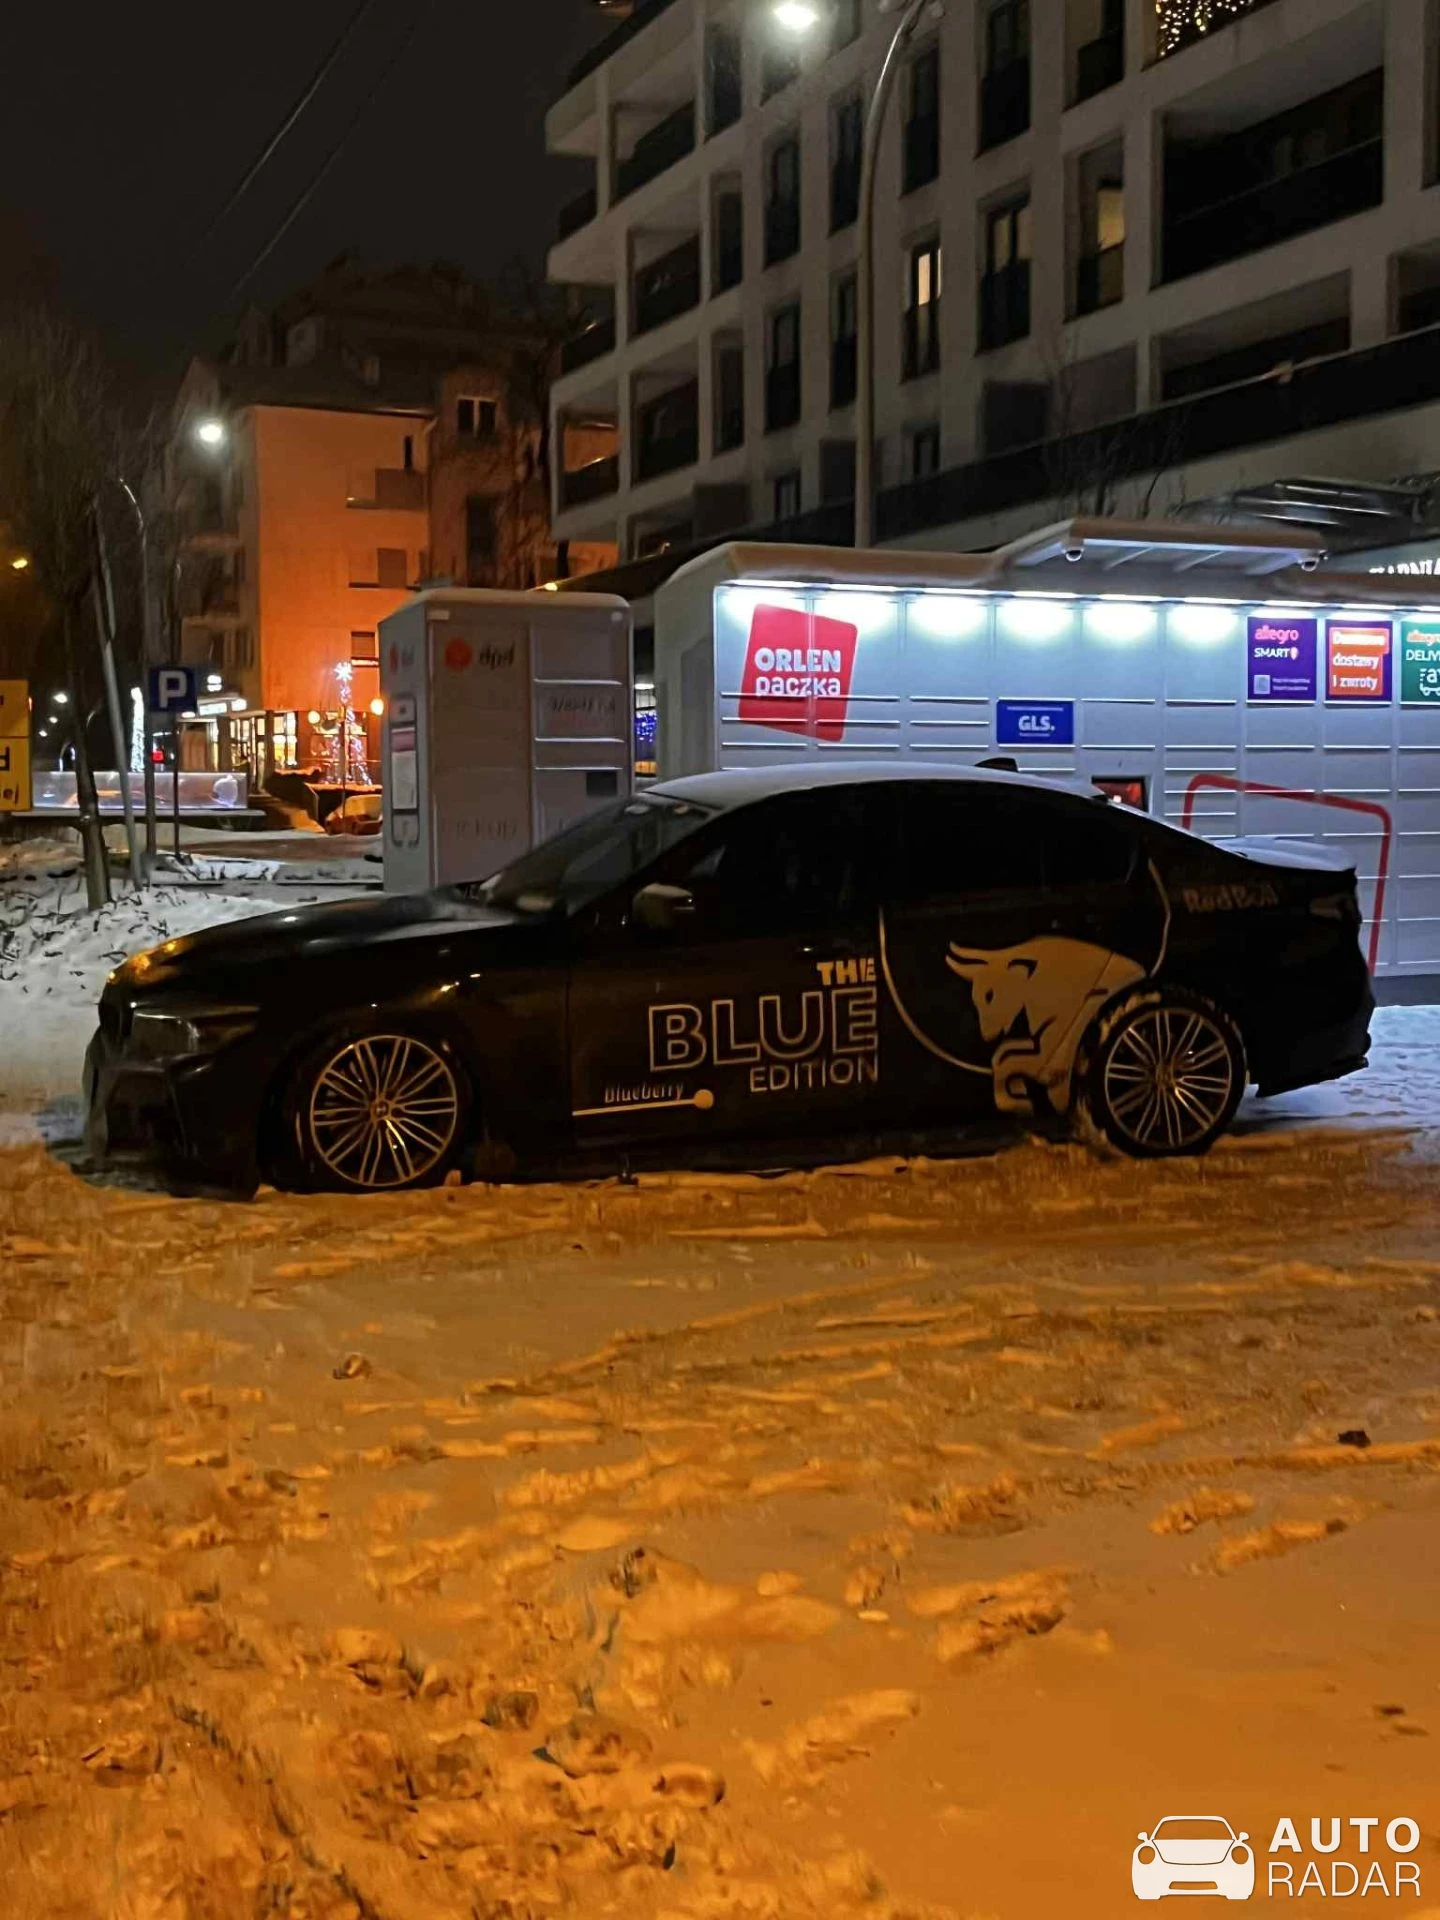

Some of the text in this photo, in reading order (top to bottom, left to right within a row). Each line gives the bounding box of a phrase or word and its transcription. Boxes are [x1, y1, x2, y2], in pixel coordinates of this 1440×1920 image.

[1254, 625, 1299, 644] allegro
[755, 647, 841, 672] ORLEN
[1406, 649, 1440, 661] DELIV
[158, 670, 187, 708] P
[756, 676, 841, 697] paczka
[816, 957, 876, 985] THE
[649, 987, 878, 1072] BLUE
[750, 1055, 878, 1092] EDITION
